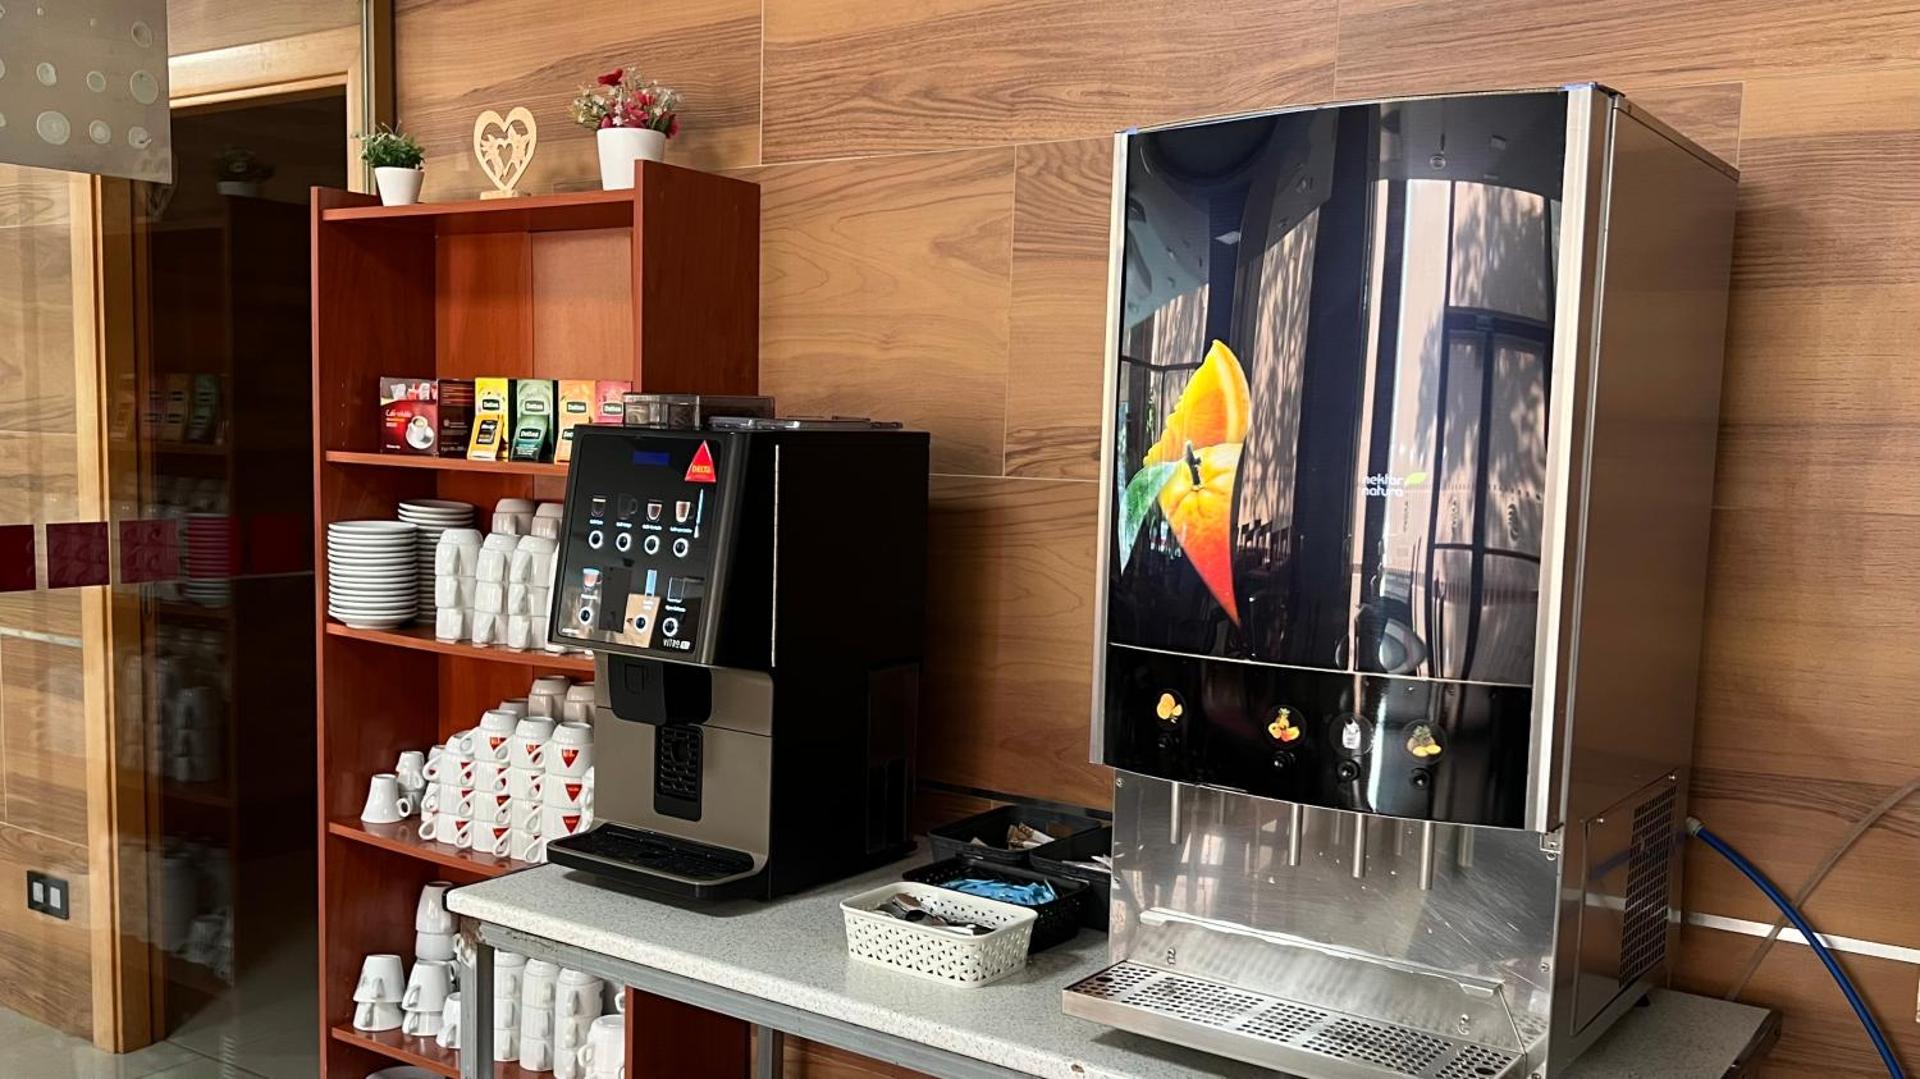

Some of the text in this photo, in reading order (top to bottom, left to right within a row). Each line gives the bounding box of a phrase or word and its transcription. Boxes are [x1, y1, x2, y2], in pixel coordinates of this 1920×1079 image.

[692, 465, 711, 473] DELTA
[1363, 473, 1403, 485] nektar
[1362, 485, 1403, 497] natura
